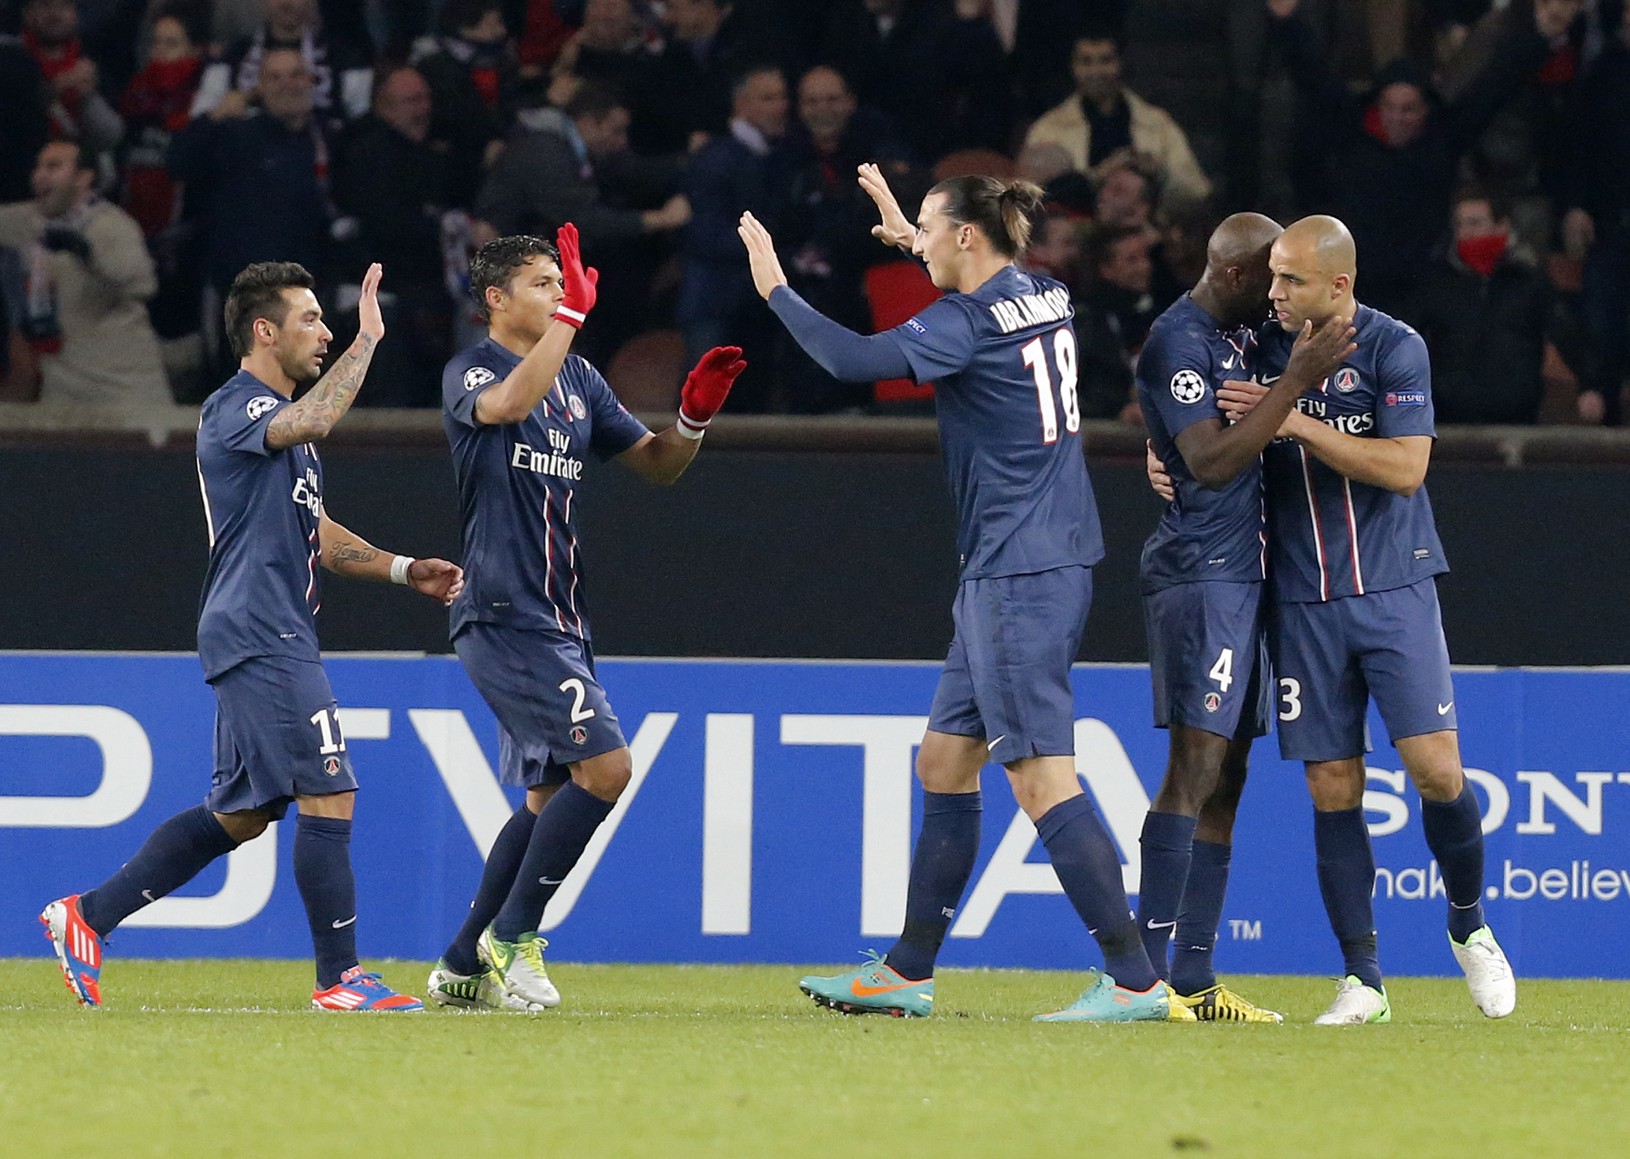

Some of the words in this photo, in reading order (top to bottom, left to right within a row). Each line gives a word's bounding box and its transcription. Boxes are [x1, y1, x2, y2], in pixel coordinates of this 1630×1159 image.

[1020, 326, 1080, 445] 18
[548, 428, 571, 454] Fly
[1209, 648, 1233, 693] 4
[559, 678, 596, 724] 2
[1279, 677, 1302, 721] 3
[310, 708, 346, 755] 11
[1362, 766, 1630, 838] SON
[1228, 919, 1261, 941] TM
